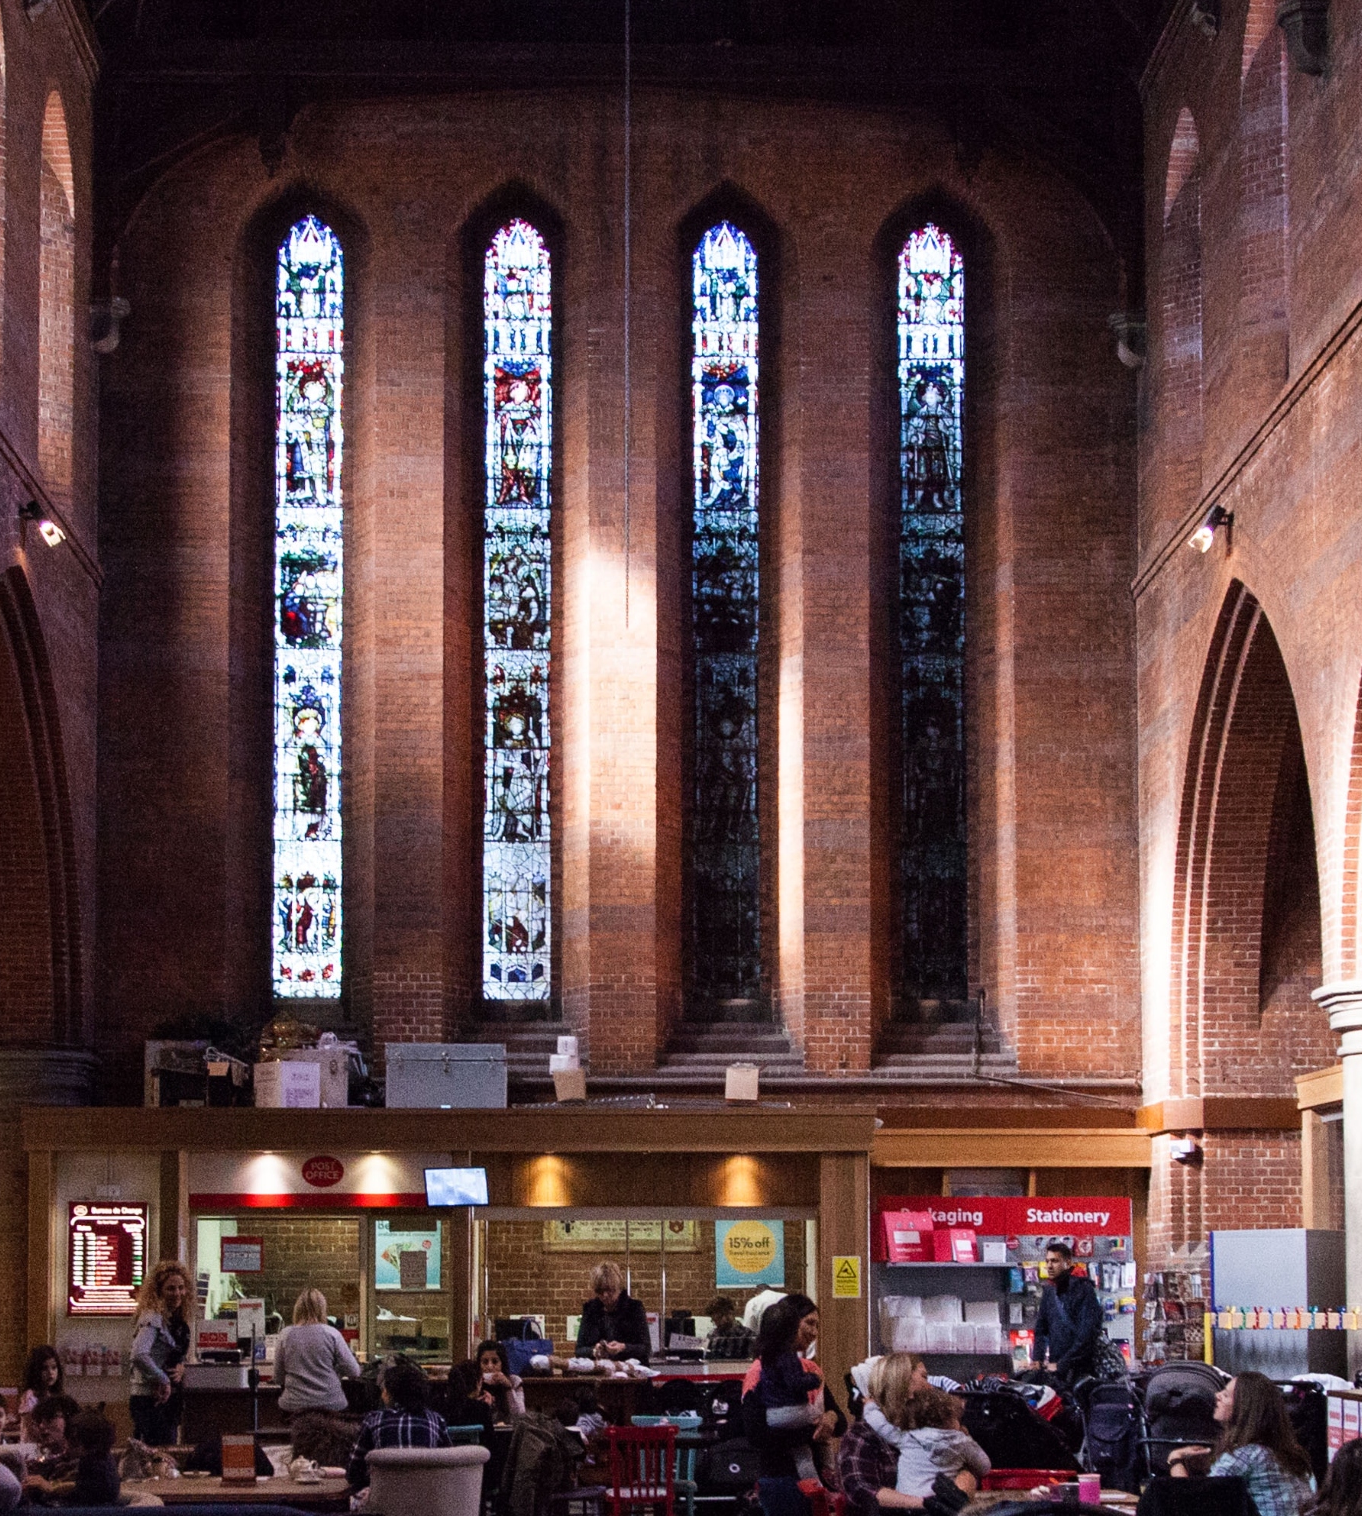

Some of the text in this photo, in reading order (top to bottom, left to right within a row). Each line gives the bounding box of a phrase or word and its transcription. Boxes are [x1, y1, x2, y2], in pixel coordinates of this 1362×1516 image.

[311, 1162, 335, 1170] POST
[305, 1170, 339, 1179] OFFICE
[901, 1207, 1111, 1227] kaging Stationery
[729, 1237, 770, 1249] 15% off
